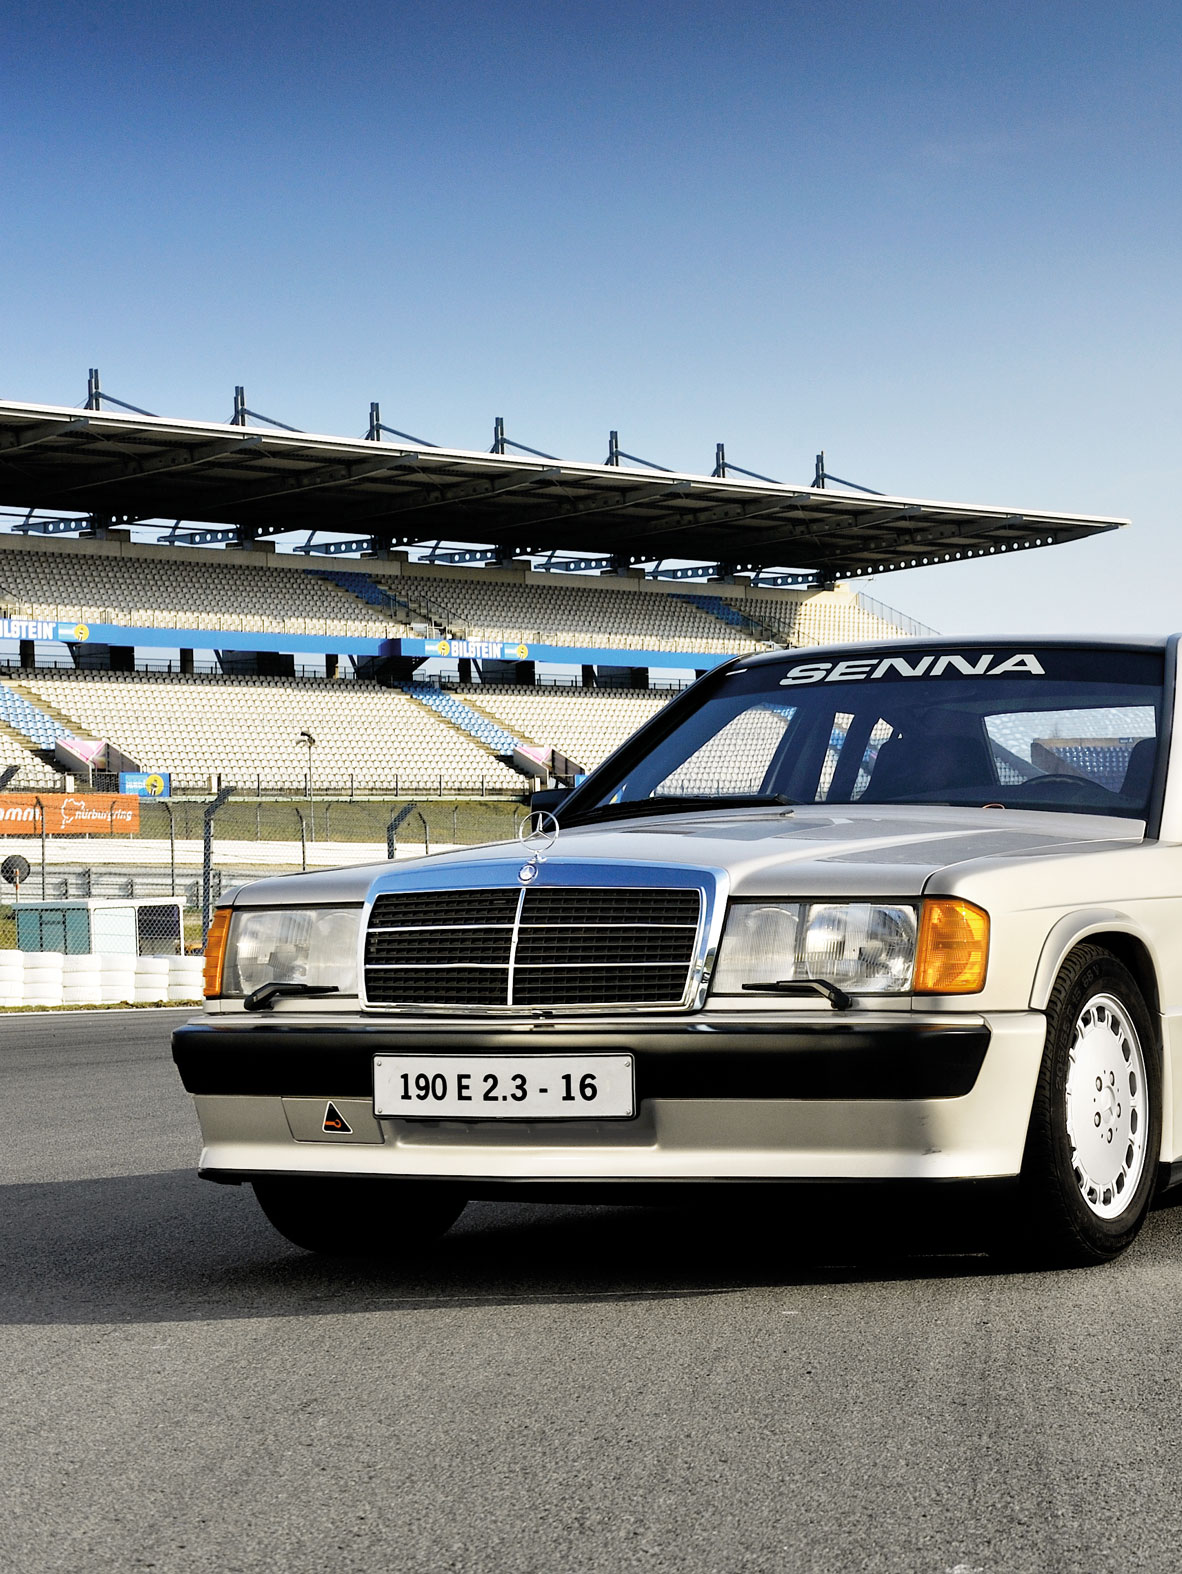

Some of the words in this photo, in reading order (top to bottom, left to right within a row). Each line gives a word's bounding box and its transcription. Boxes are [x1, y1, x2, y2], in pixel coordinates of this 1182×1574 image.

[451, 641, 502, 659] BILSTEIN
[779, 653, 1046, 686] SENNA
[400, 1073, 447, 1101] 190
[457, 1074, 472, 1100] E
[482, 1073, 528, 1101] 2.3
[561, 1073, 598, 1101] 16
